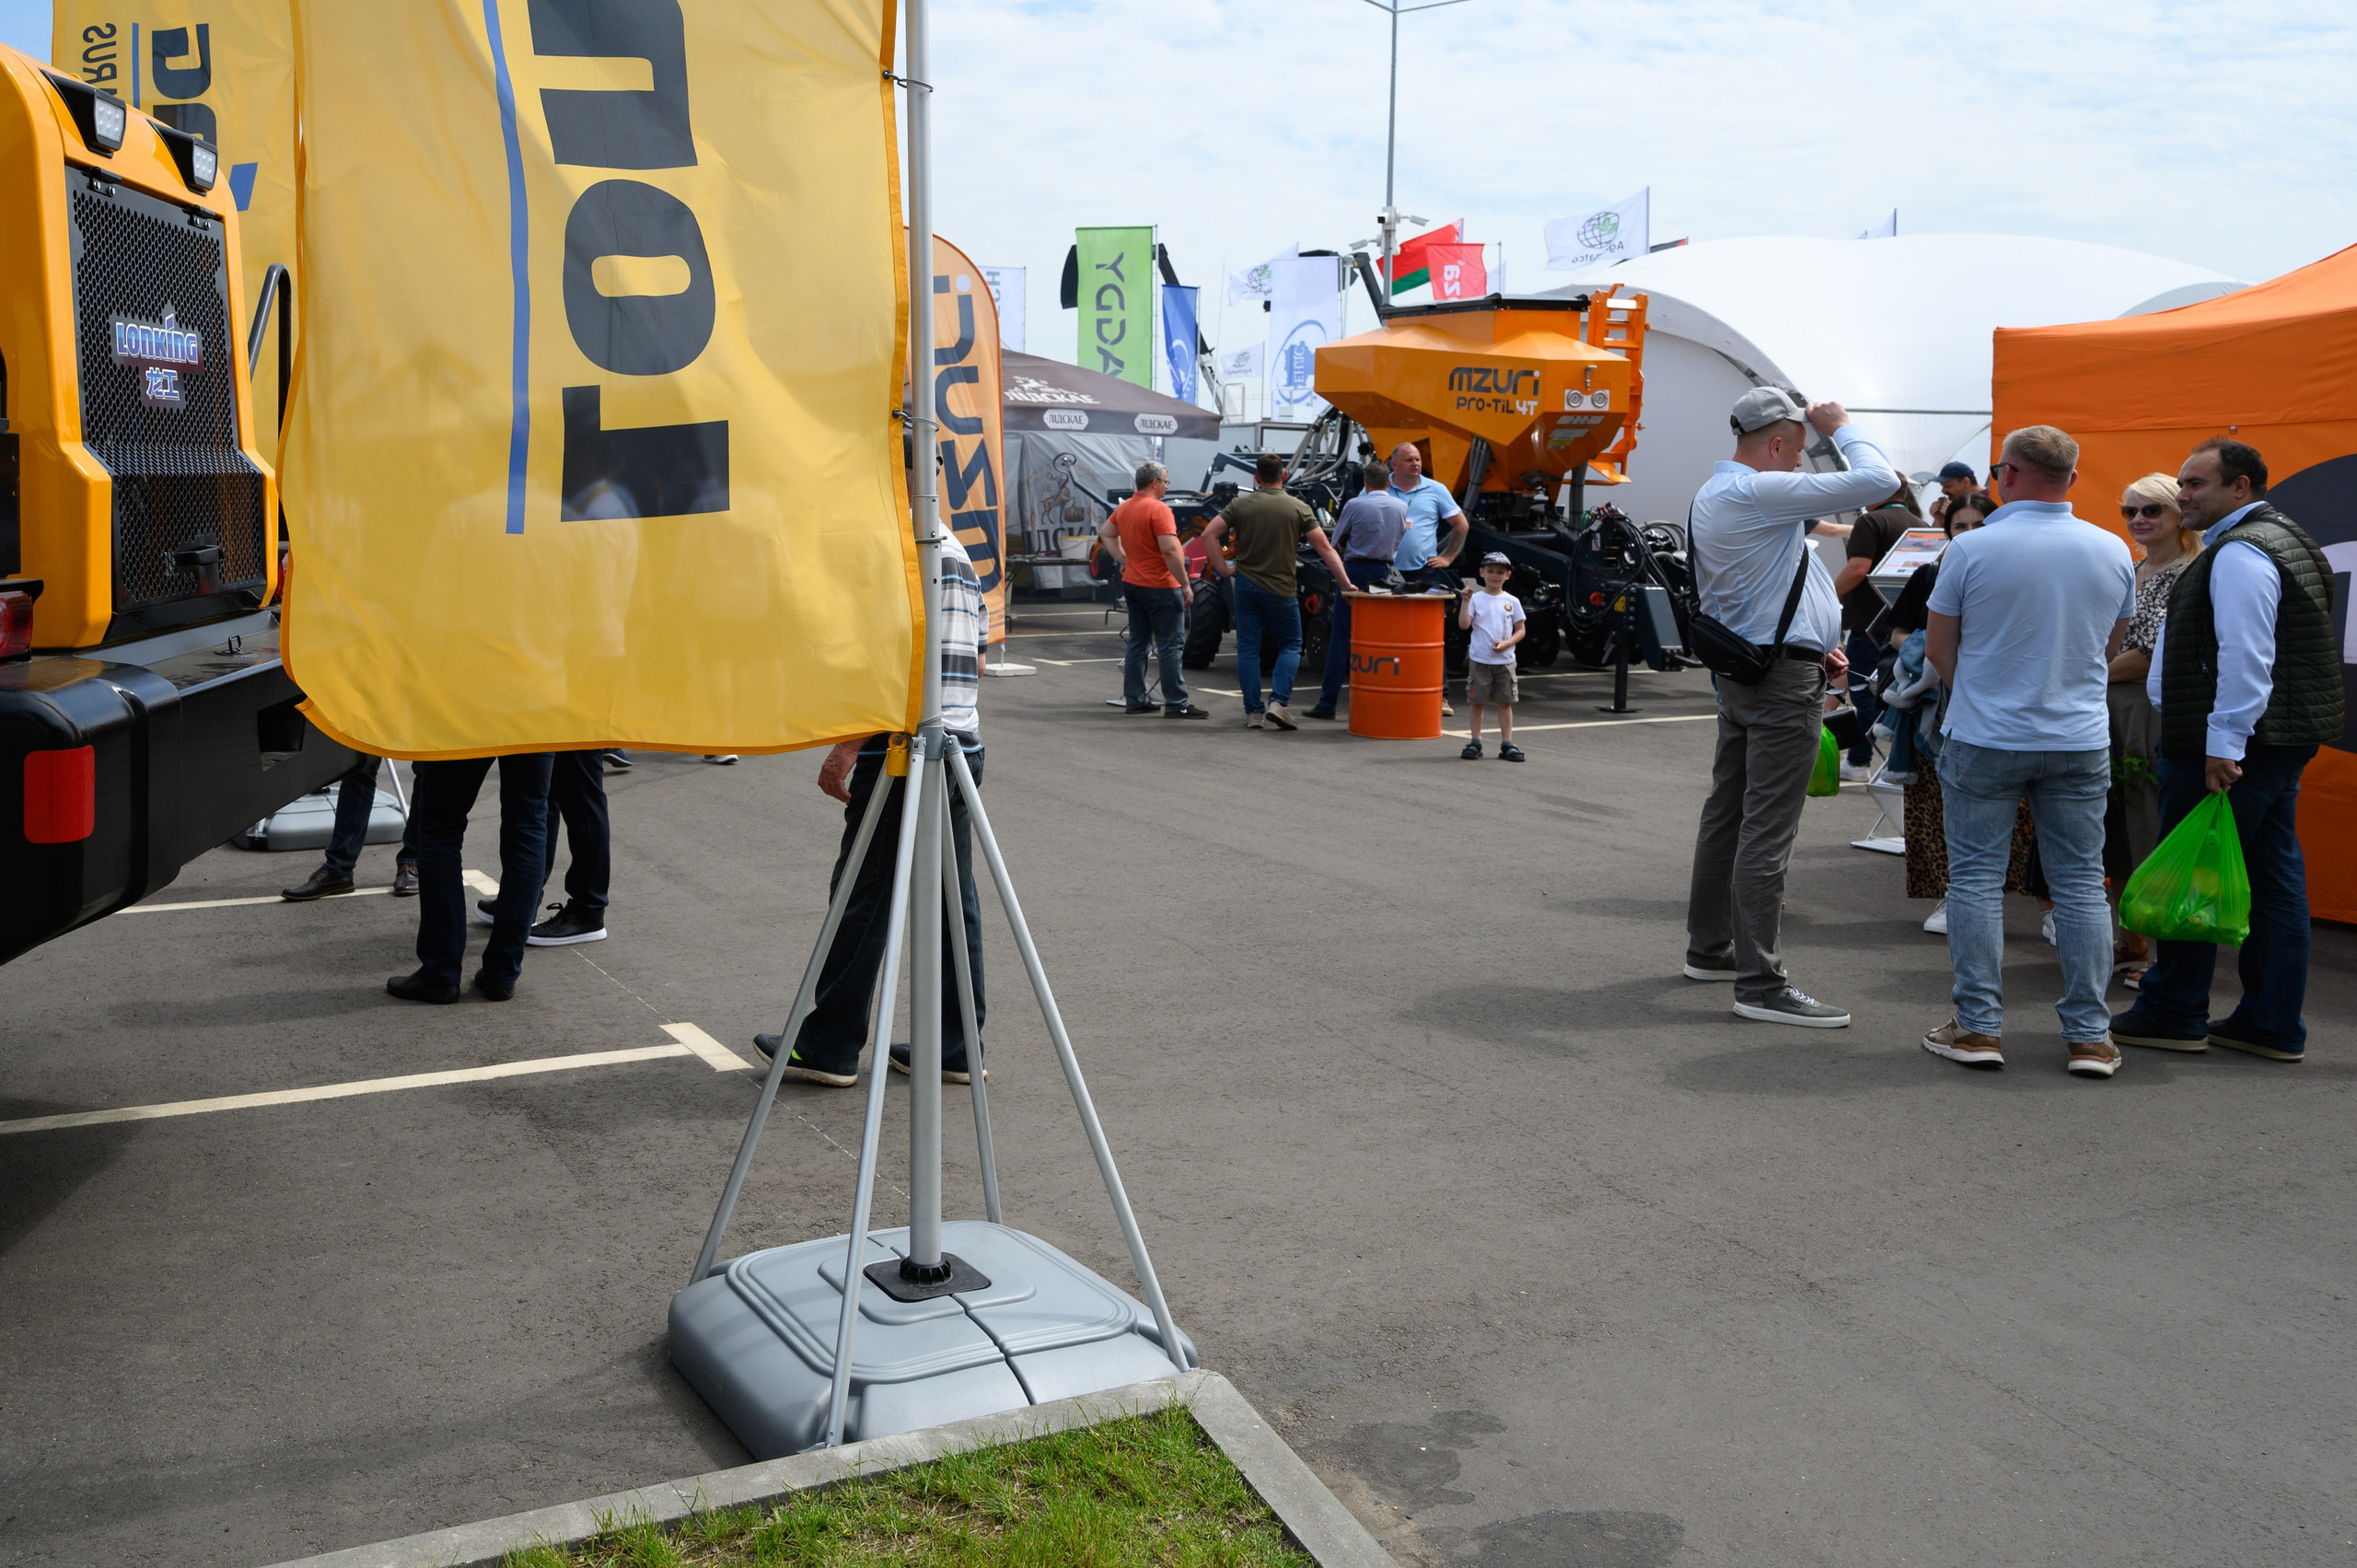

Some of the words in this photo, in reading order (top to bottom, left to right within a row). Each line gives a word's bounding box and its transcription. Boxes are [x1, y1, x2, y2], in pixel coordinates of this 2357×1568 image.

[116, 313, 199, 365] LONKING
[1448, 366, 1540, 396] mzuri
[1048, 413, 1084, 425] ЛІДСКАЕ
[1139, 418, 1173, 430] ЛІДСКАЕ
